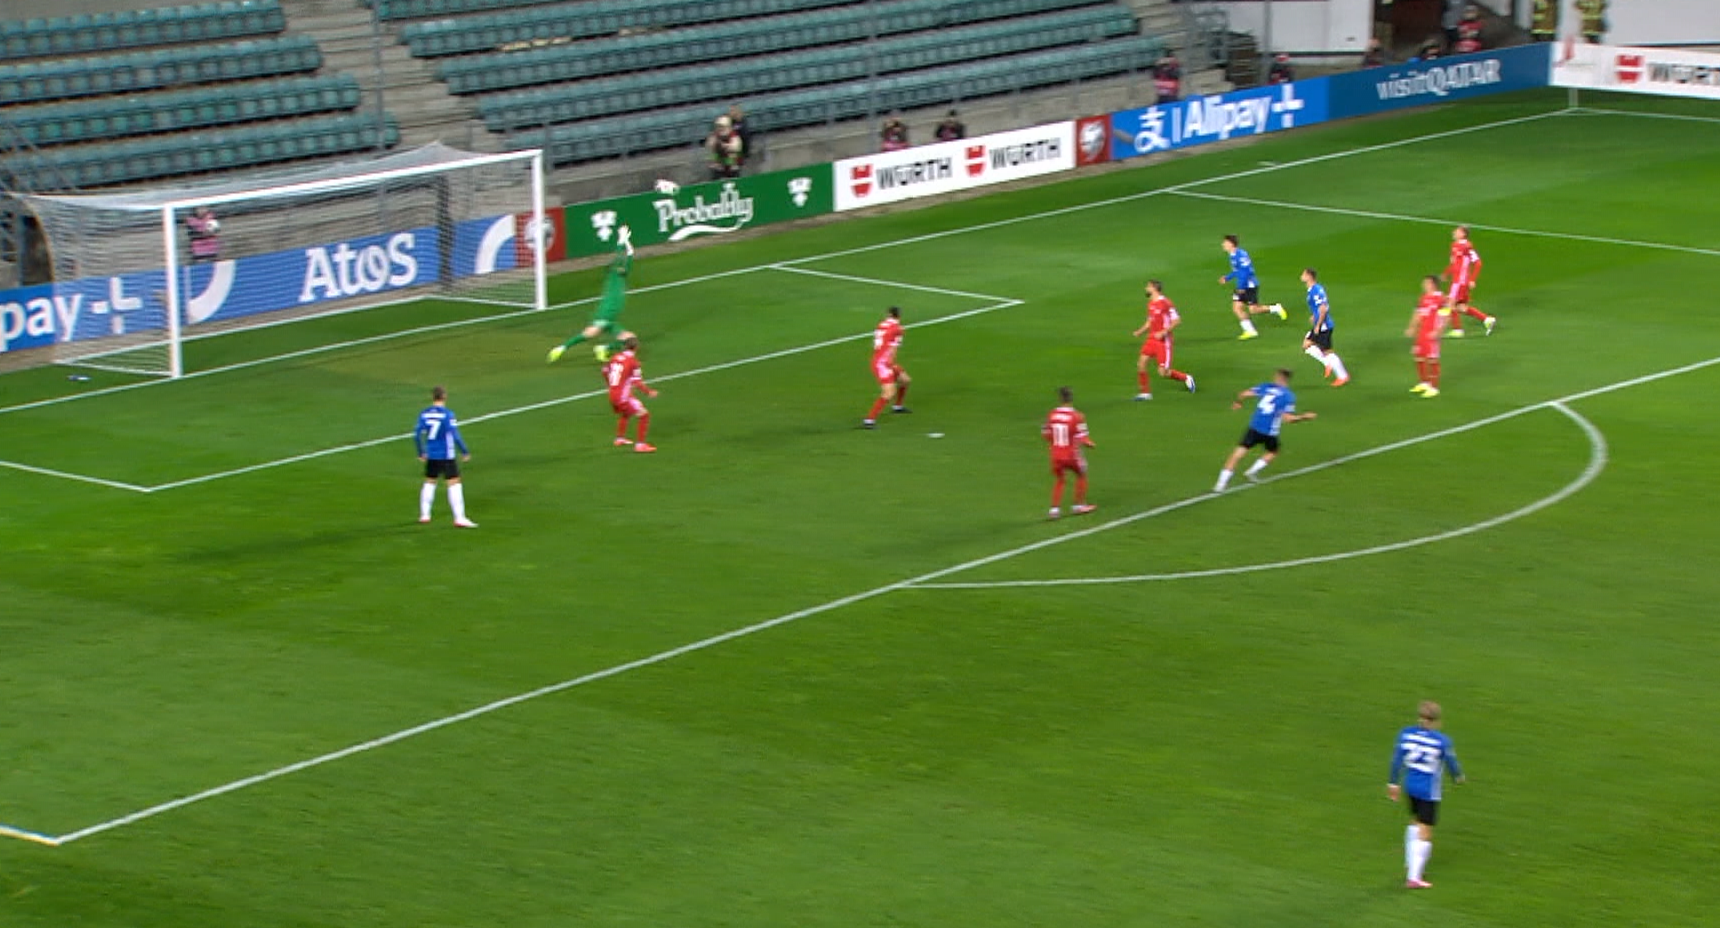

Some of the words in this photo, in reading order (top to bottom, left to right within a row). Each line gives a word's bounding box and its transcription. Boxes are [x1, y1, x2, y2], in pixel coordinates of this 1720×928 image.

[1376, 59, 1501, 100] visitQATAR
[652, 182, 754, 233] Probably
[1257, 394, 1276, 415] 4
[425, 419, 441, 440] 7
[1401, 743, 1441, 774] 23
